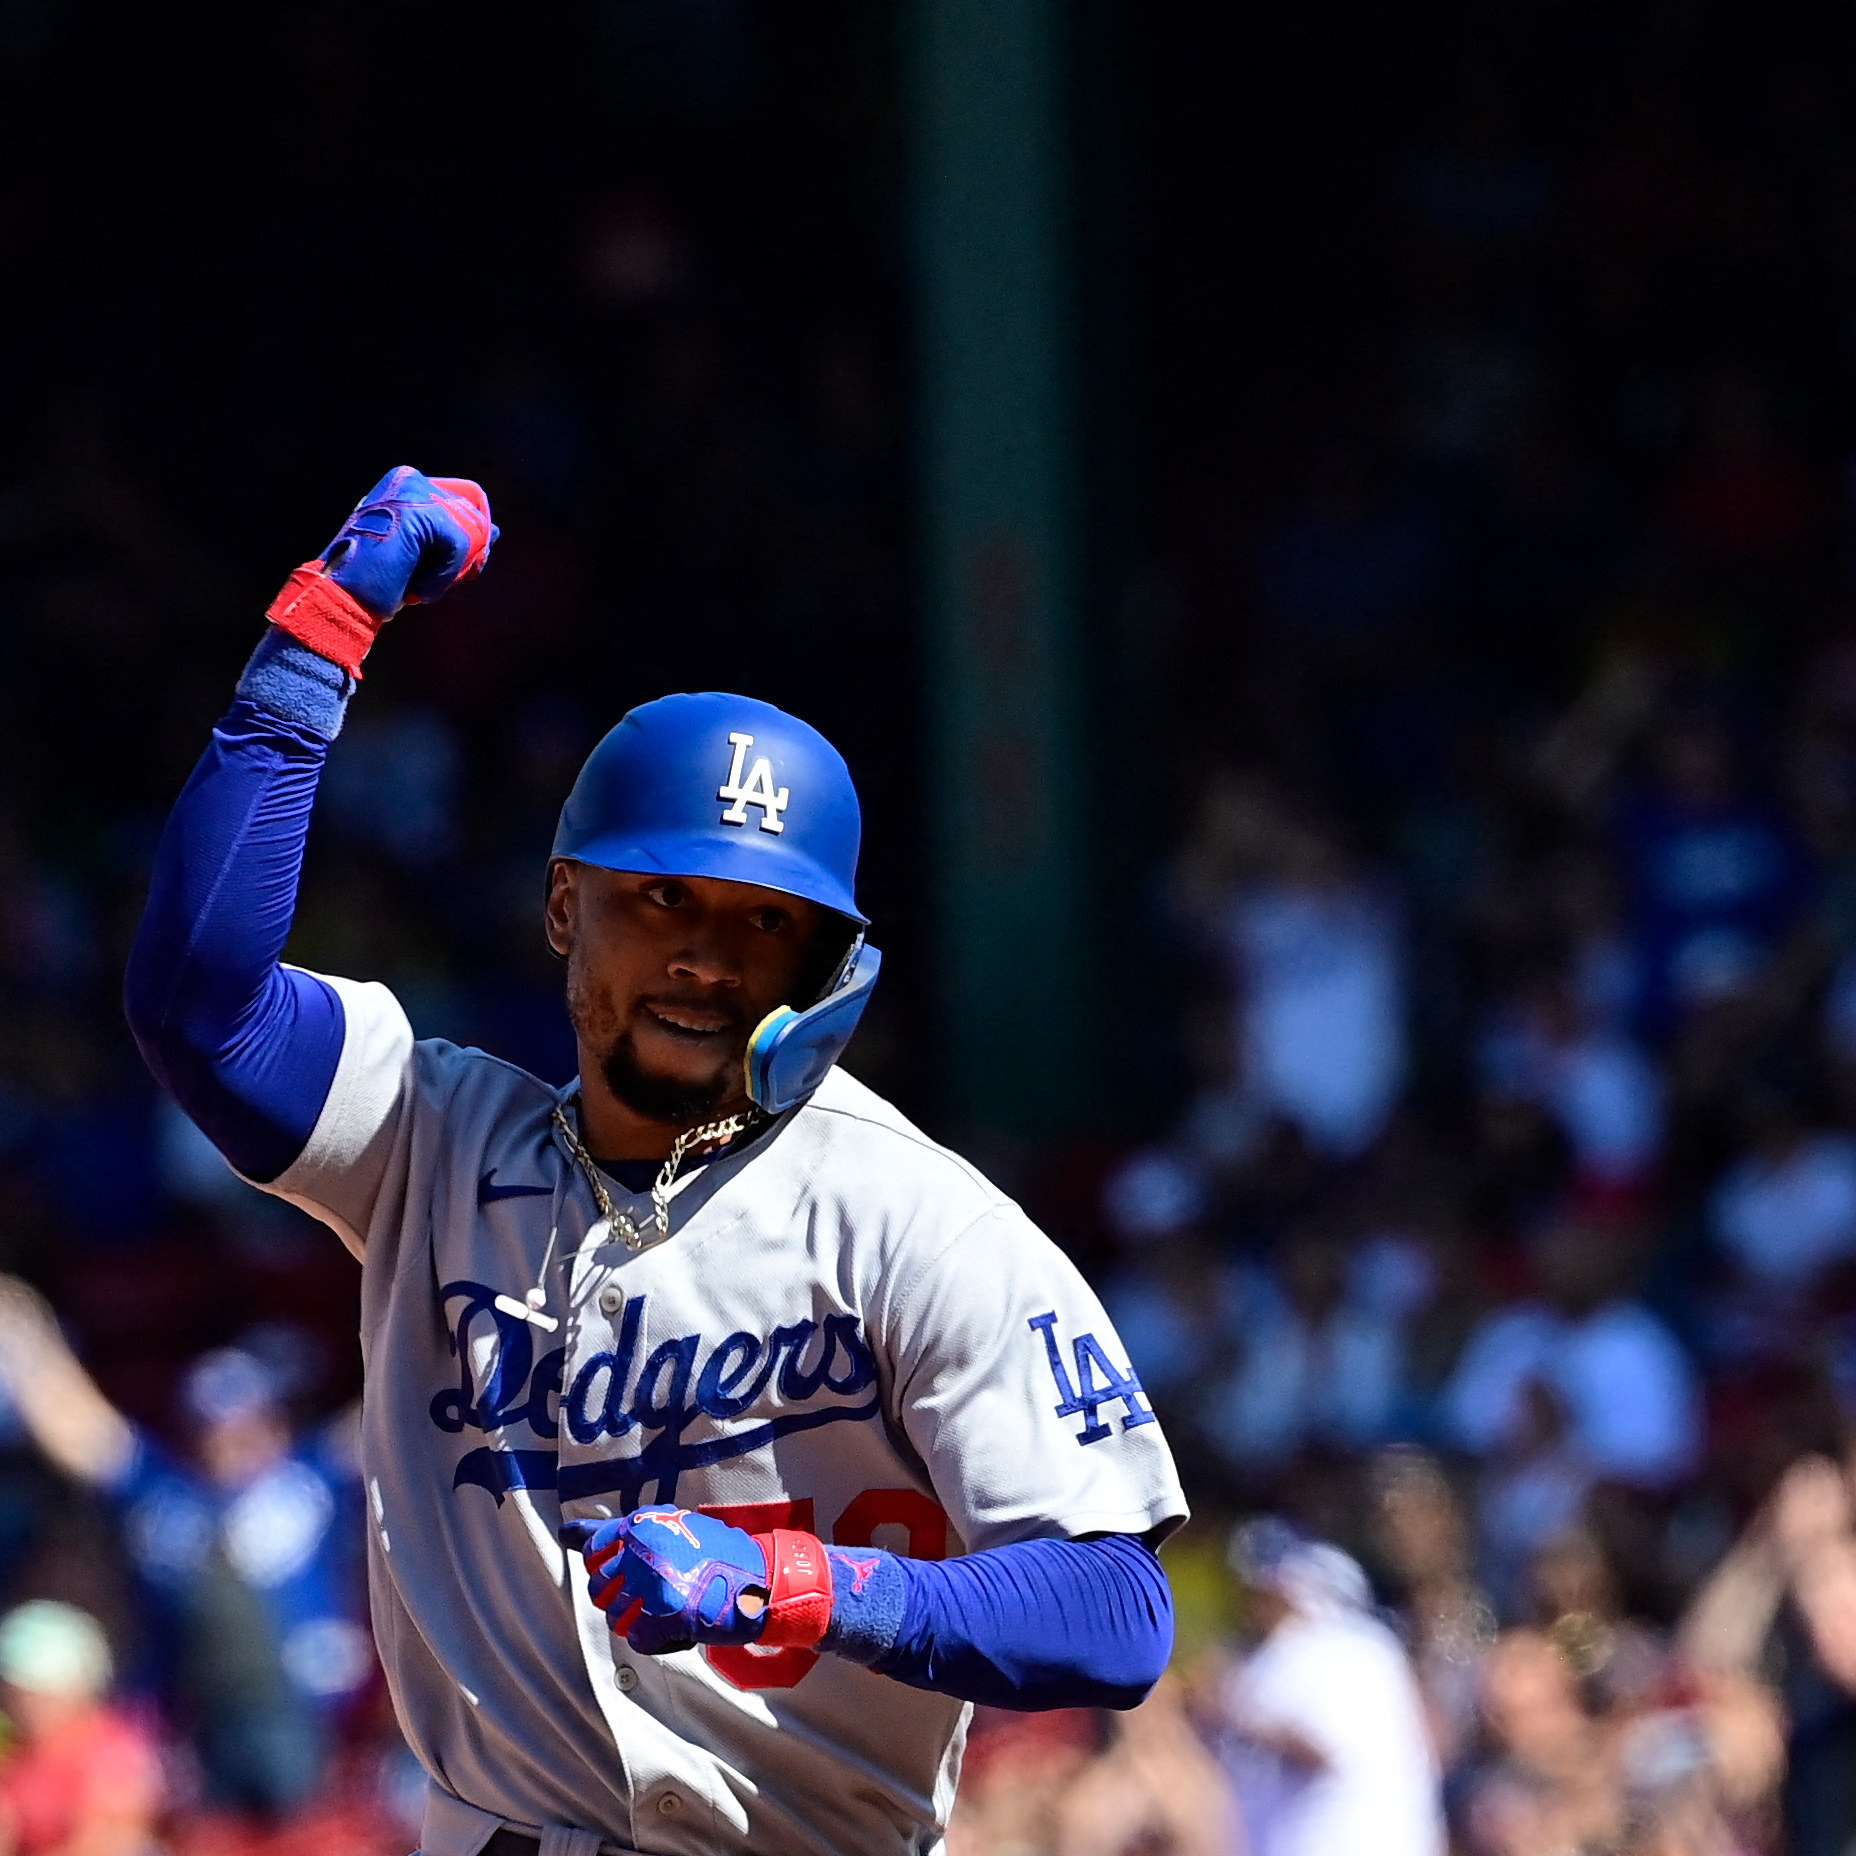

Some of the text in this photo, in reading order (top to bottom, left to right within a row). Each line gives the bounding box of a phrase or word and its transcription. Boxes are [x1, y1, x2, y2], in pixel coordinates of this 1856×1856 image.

[716, 732, 790, 836] LA
[429, 1280, 881, 1490] Dodgers
[1027, 1311, 1155, 1446] LA
